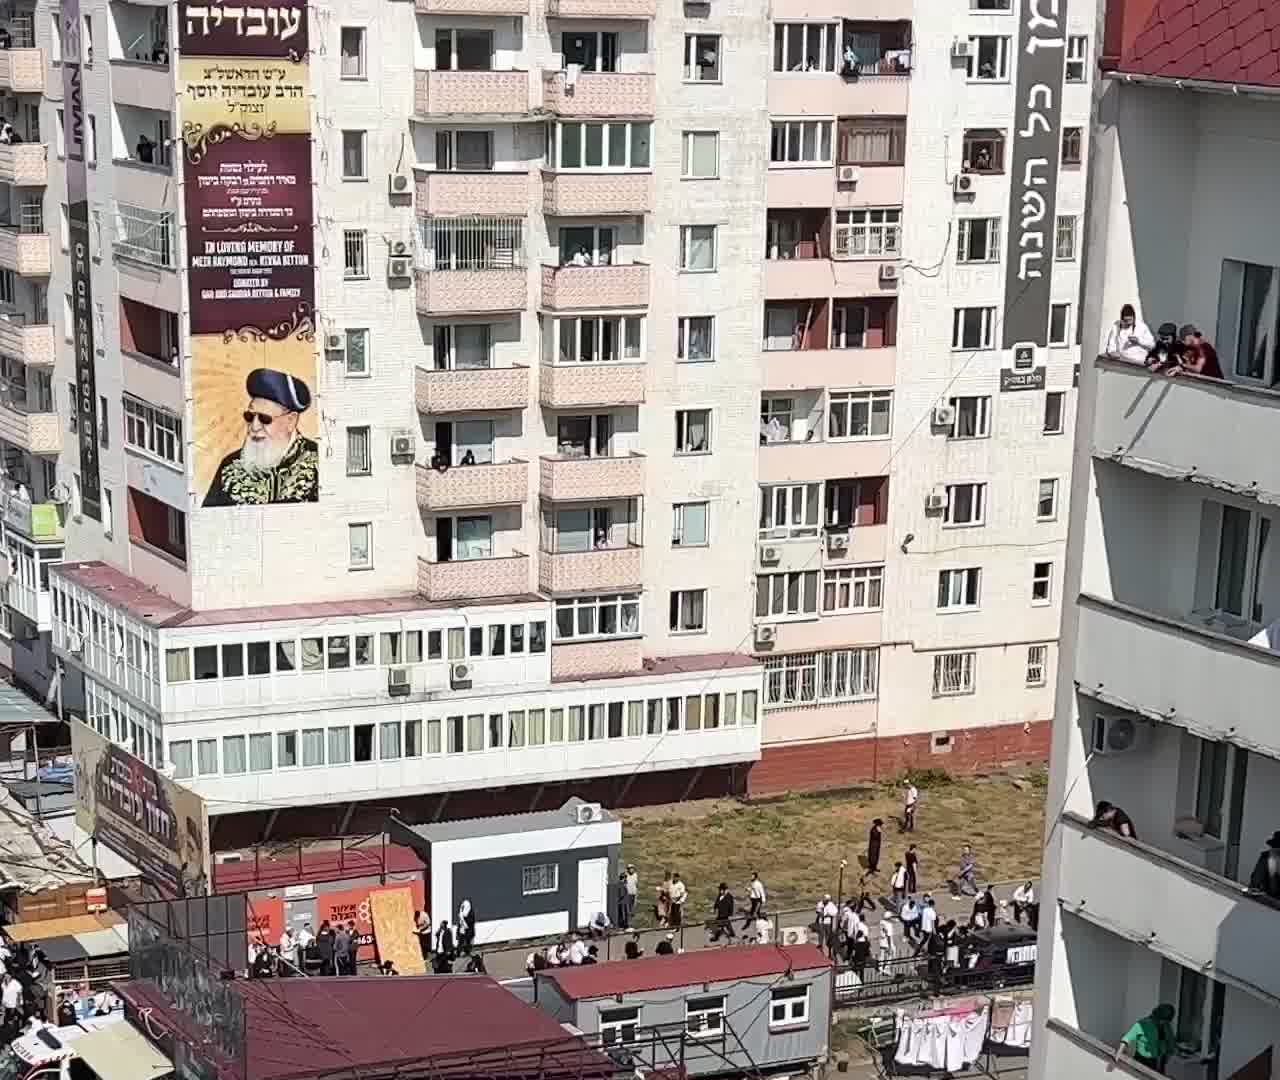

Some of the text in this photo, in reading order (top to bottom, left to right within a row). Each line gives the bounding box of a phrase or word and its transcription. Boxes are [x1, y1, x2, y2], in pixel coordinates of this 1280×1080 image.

[186, 6, 301, 40] עובדיה
[186, 84, 303, 100] הרב עובדיה יוסף
[1020, 84, 1051, 138] כל
[1018, 158, 1049, 280] השנה
[205, 240, 295, 254] IN LOVING MEMORY OF
